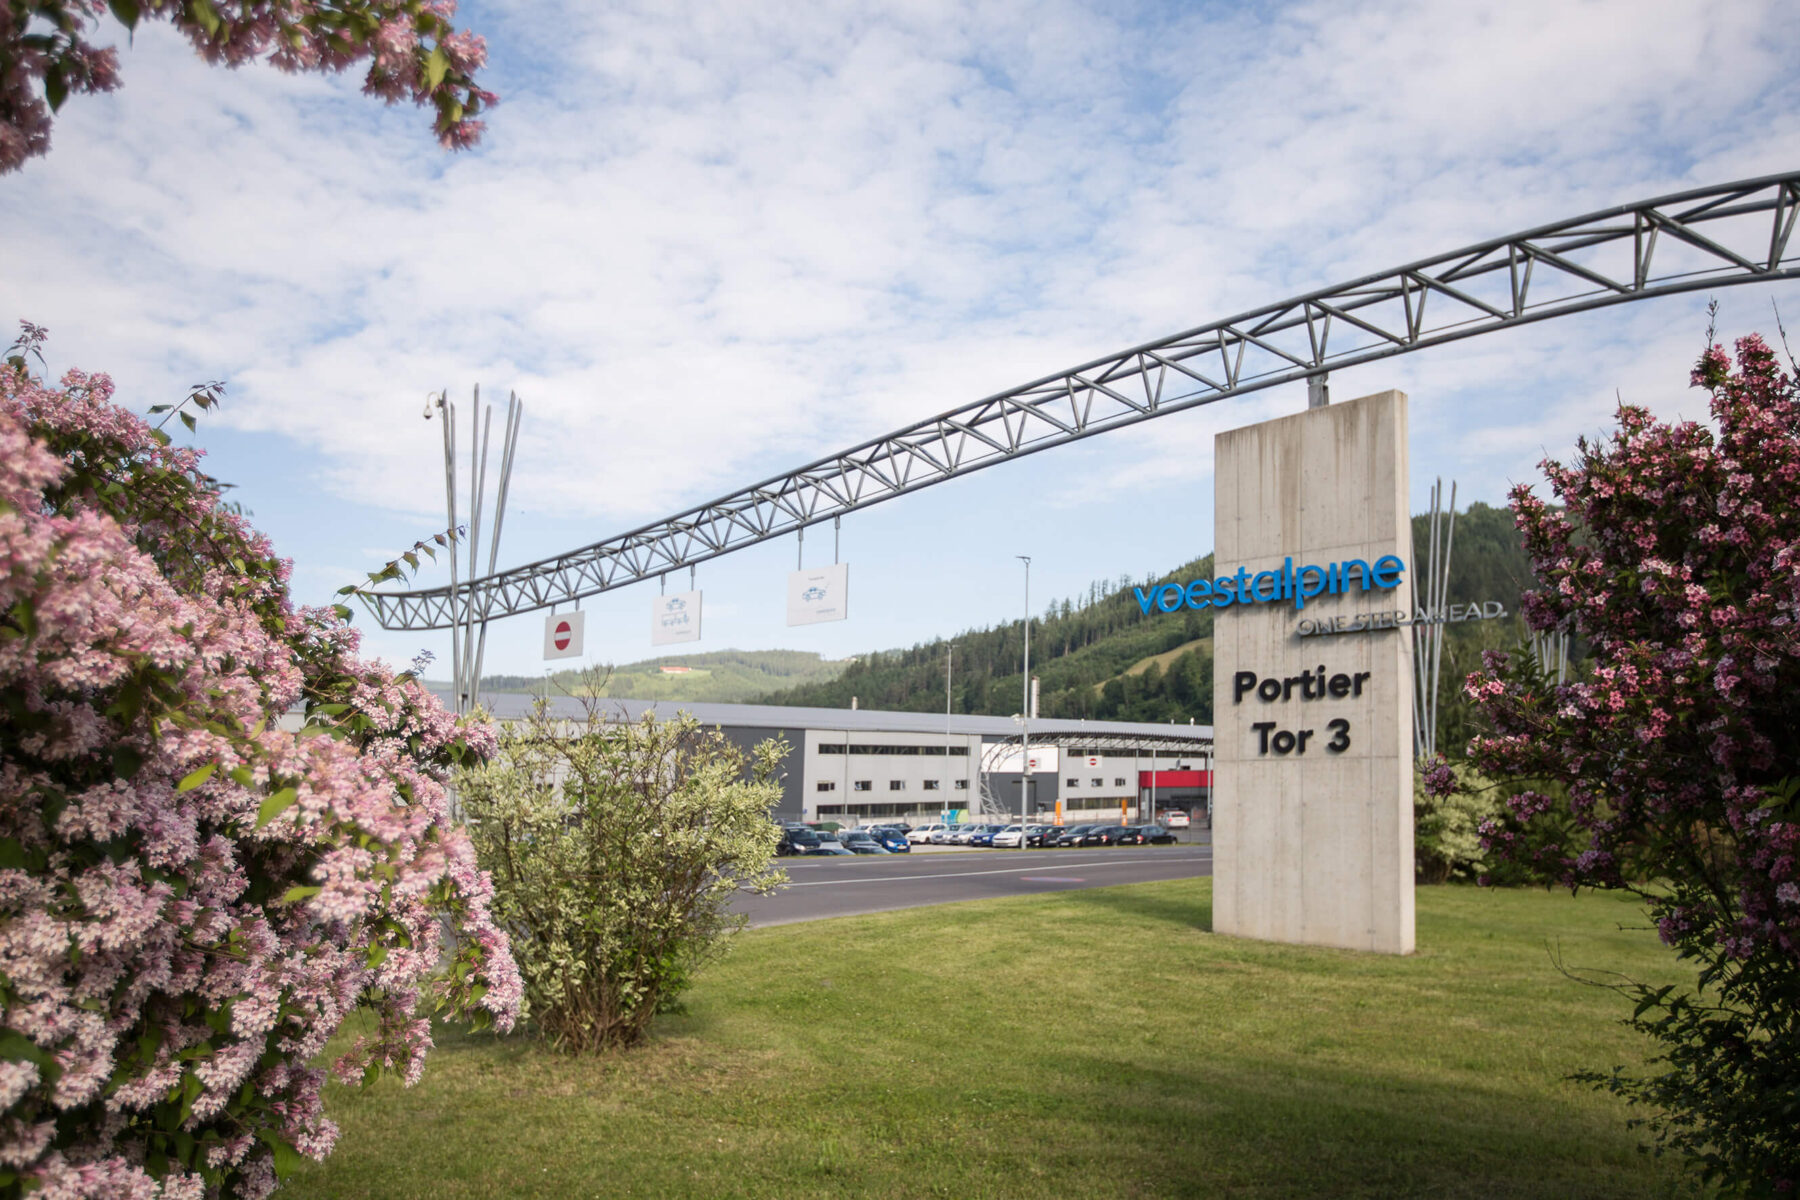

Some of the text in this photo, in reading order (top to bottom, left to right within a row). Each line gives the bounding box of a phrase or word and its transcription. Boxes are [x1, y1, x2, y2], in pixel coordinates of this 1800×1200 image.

[1134, 555, 1405, 615] voestalpine
[1297, 615, 1346, 636] ONE
[1355, 609, 1406, 630] STEP
[1235, 665, 1371, 703] Portier
[1252, 718, 1350, 754] Tor 3
